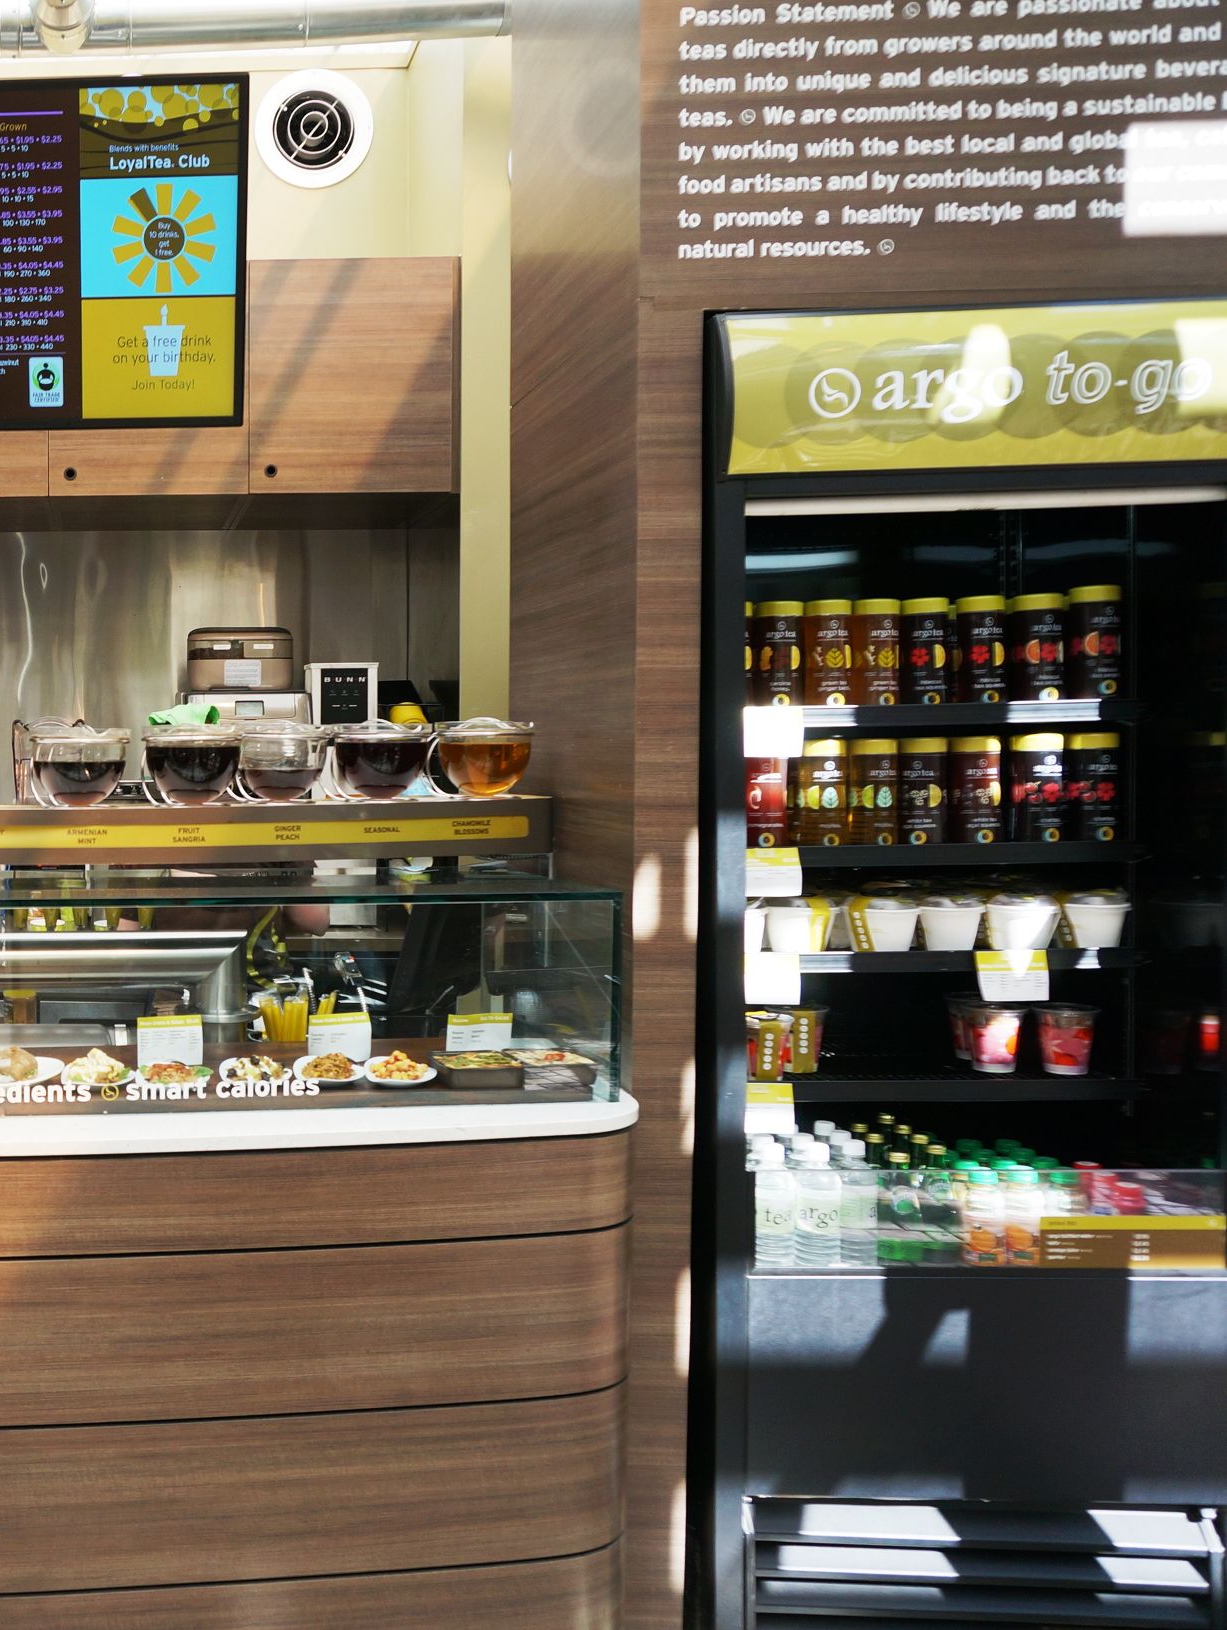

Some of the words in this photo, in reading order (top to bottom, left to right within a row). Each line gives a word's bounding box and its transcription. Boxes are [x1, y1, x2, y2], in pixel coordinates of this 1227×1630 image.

[679, 5, 765, 27] Passion
[775, 1, 894, 24] Statement
[928, 0, 961, 18] We
[970, 0, 1008, 17] are
[679, 41, 727, 60] teas
[733, 37, 819, 61] directly
[825, 36, 878, 56] from
[884, 34, 973, 58] growers
[977, 29, 1058, 51] around
[1063, 28, 1102, 48] the
[1109, 24, 1172, 46] world
[1178, 22, 1221, 43] and
[679, 75, 736, 94] them
[744, 73, 788, 92] into
[796, 70, 872, 94] unique
[878, 67, 921, 89] and
[928, 65, 1029, 87] delicious
[1037, 62, 1147, 86] signature
[679, 108, 733, 128] teas.
[762, 106, 796, 125] We
[800, 107, 837, 124] are
[841, 101, 962, 123] committed
[966, 100, 992, 121] to
[996, 98, 1058, 121] being
[1062, 101, 1077, 118] a
[1082, 92, 1216, 116] sustainable
[0, 123, 27, 131] Grown
[678, 142, 705, 165] by
[712, 140, 799, 163] working
[805, 138, 854, 158] with
[860, 136, 899, 157] the
[904, 135, 955, 156] best
[961, 133, 1015, 155] local
[1021, 132, 1063, 153] and
[179, 154, 210, 168] Club
[678, 175, 726, 195] food
[730, 173, 822, 193] artisans
[826, 171, 867, 191] and
[872, 170, 900, 194] by
[903, 167, 1043, 193] contributing
[1046, 165, 1101, 185] back
[1103, 164, 1127, 183] to
[678, 209, 701, 228] to
[714, 207, 803, 231] promote
[815, 210, 829, 225] a
[841, 204, 924, 228] healthy
[935, 201, 1024, 225] lifestyle
[1034, 200, 1077, 220] and
[1088, 199, 1125, 219] the
[678, 239, 754, 259] natural
[760, 240, 871, 257] resources.
[117, 336, 137, 348] Get
[142, 339, 148, 347] a
[153, 336, 177, 347] free
[181, 335, 212, 347] drink
[113, 355, 128, 363] on
[132, 353, 159, 366] your
[163, 351, 216, 364] birthday.
[132, 380, 155, 390] Join
[160, 379, 195, 391] Today!
[873, 364, 1024, 423] argo
[1046, 349, 1214, 415] to-go
[126, 1078, 206, 1100] smart
[215, 1079, 320, 1099] calories
[801, 1207, 838, 1228] argo
